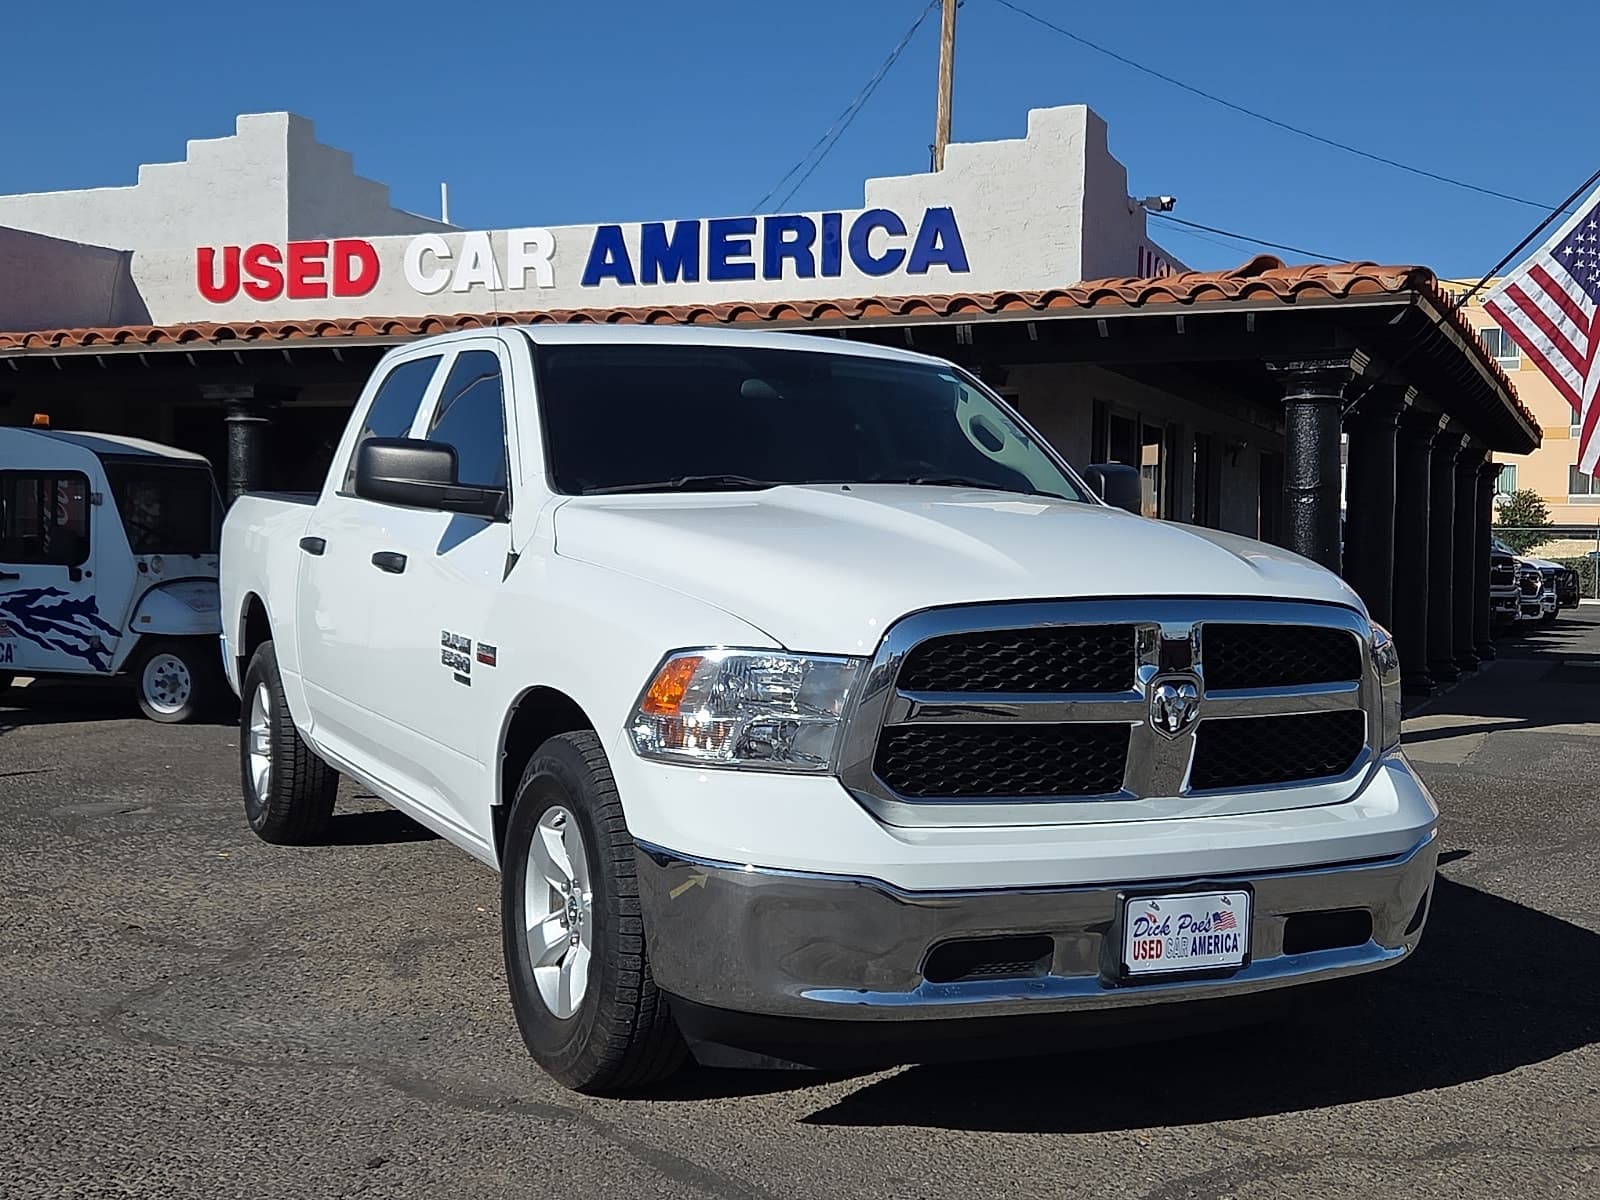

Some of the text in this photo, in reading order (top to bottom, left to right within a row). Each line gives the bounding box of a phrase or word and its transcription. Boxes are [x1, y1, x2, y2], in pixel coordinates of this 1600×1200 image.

[196, 206, 971, 303] USED CAR AMERICA
[1133, 912, 1213, 937] Dick Poe's
[1133, 933, 1239, 960] USED CAR AMERICA
